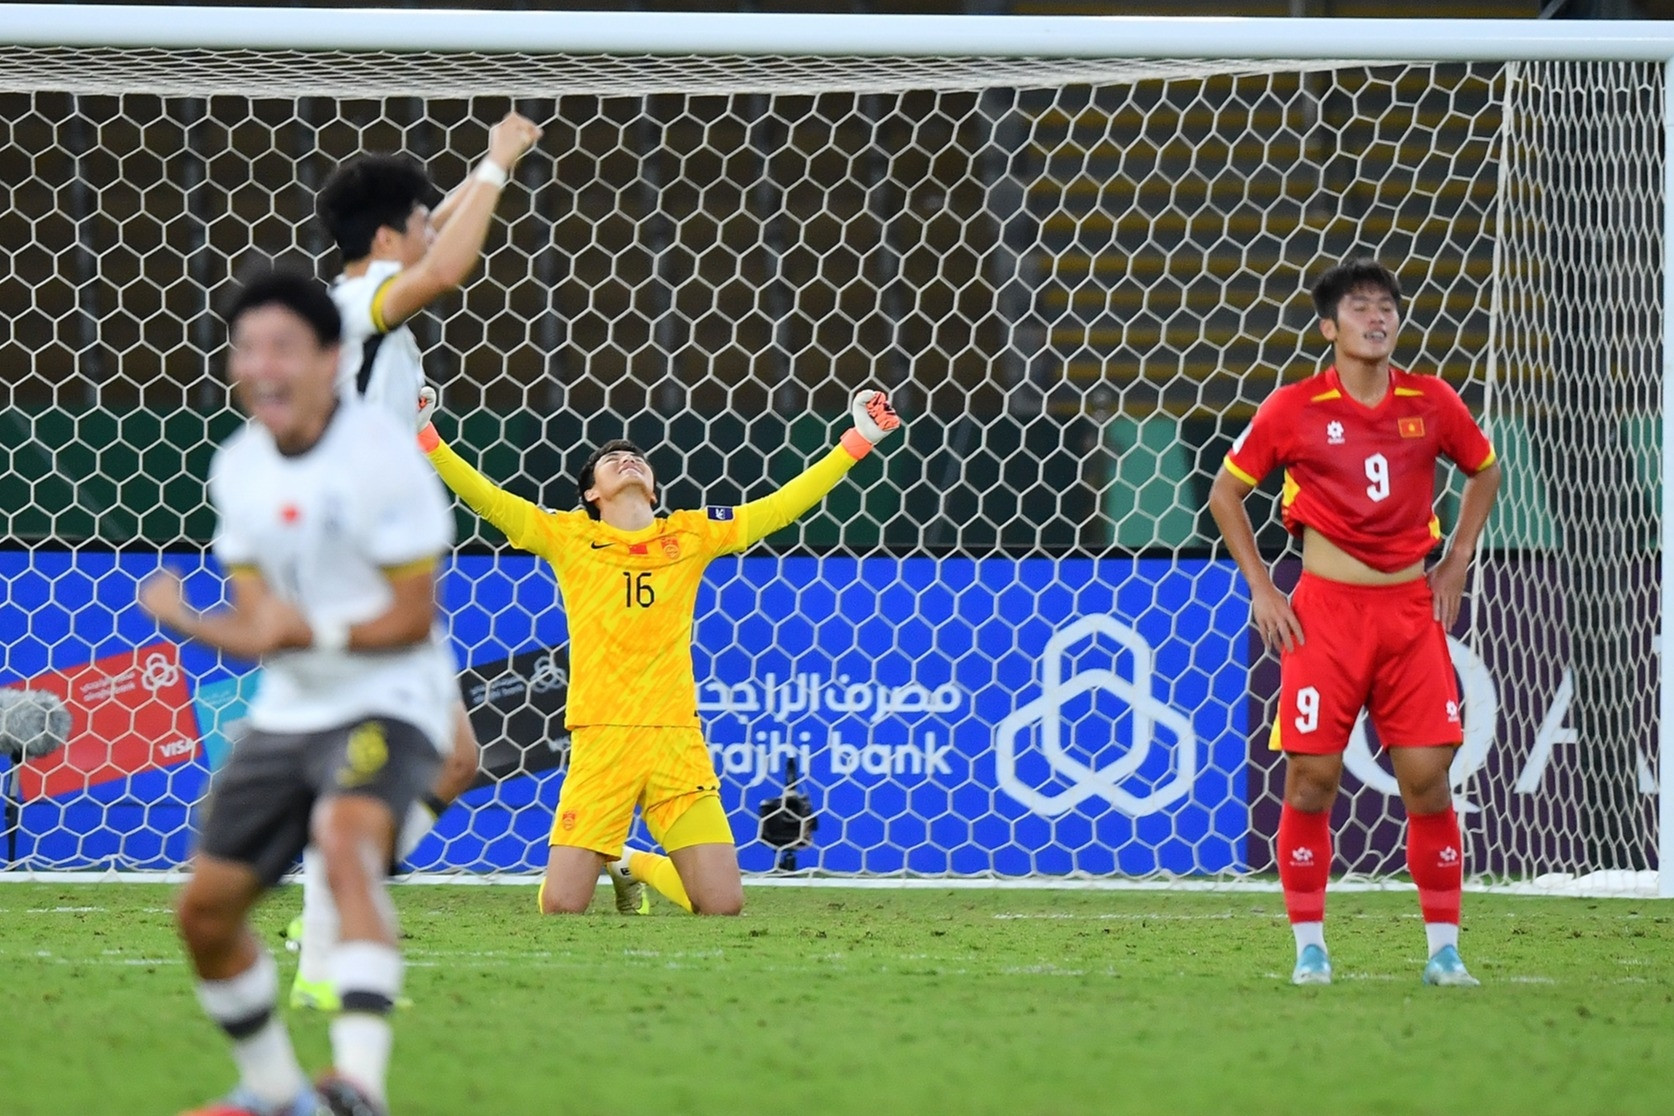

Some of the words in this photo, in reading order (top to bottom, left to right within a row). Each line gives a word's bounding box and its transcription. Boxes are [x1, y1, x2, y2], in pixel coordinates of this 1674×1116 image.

[1363, 452, 1391, 503] 9
[623, 571, 655, 608] 16
[695, 672, 820, 725] الراجح
[824, 673, 963, 723] مصرف
[1294, 686, 1321, 734] 9
[158, 738, 195, 758] VISA
[830, 730, 953, 775] bank
